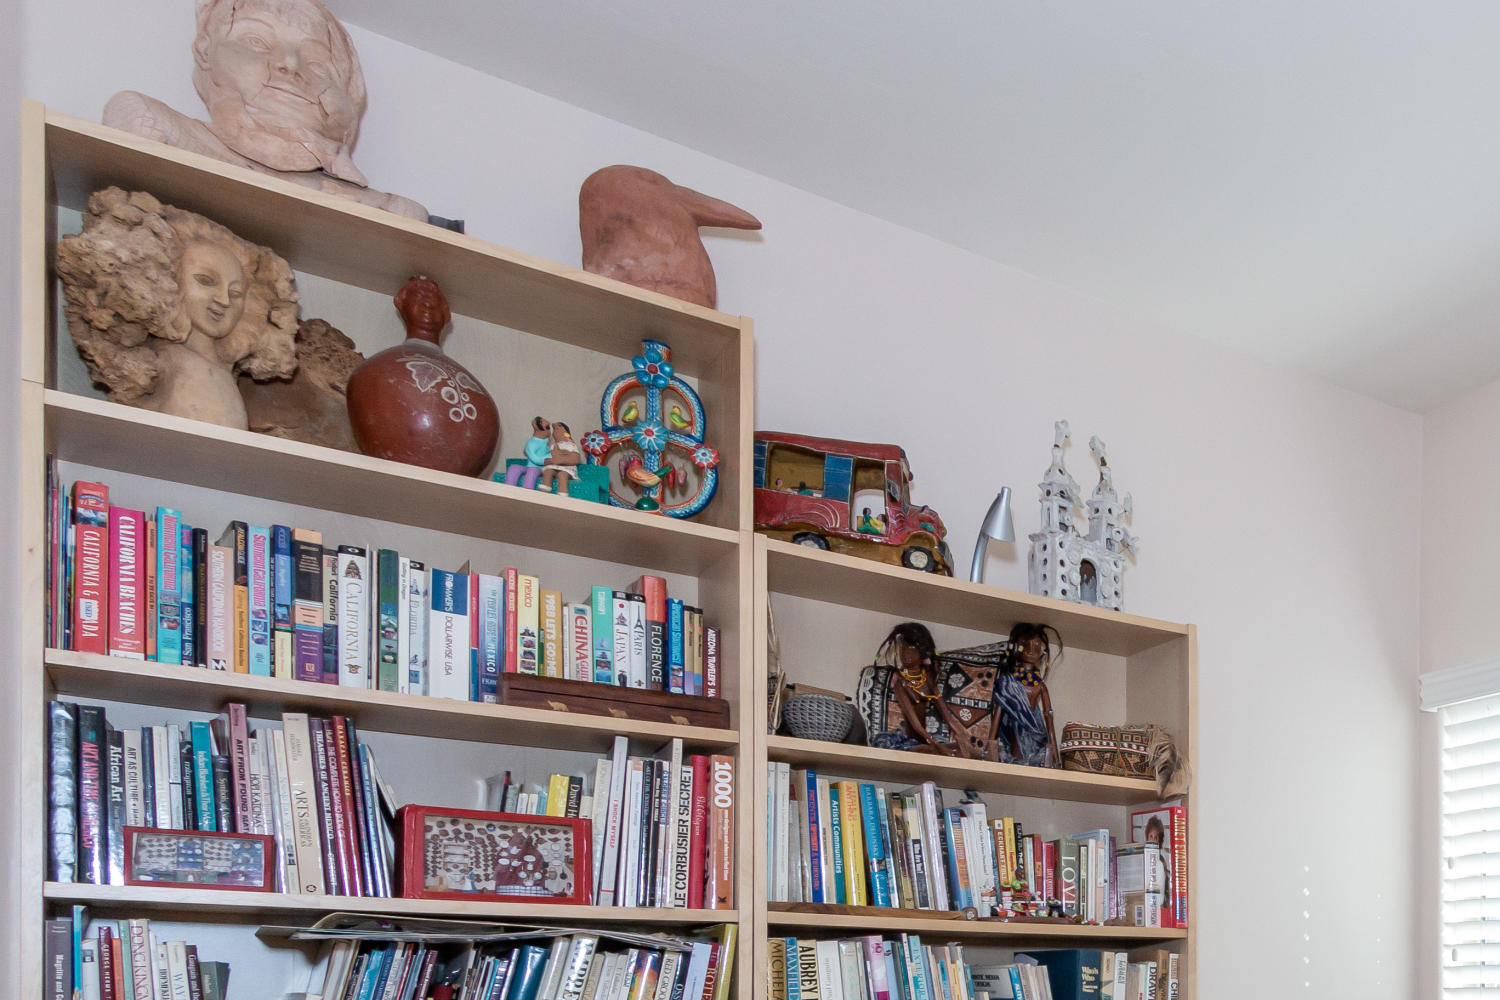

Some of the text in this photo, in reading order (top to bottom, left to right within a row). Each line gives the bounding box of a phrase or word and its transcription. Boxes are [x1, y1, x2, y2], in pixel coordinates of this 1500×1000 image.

[118, 516, 136, 636] CALIFORNIA BEACHES
[330, 579, 338, 621] California
[345, 582, 362, 661] CALIFORNIA
[574, 615, 589, 662] CHINA
[615, 629, 628, 664] JAPAN
[651, 625, 662, 683] FLORENCE
[110, 745, 123, 802] African Art
[714, 761, 732, 808] 1000
[675, 770, 692, 908] LE CORBUSIER SECRET
[832, 799, 842, 873] Artists Communities
[1062, 855, 1075, 910] LOVE
[131, 925, 146, 963] DONG
[799, 945, 816, 993] AUBREY
